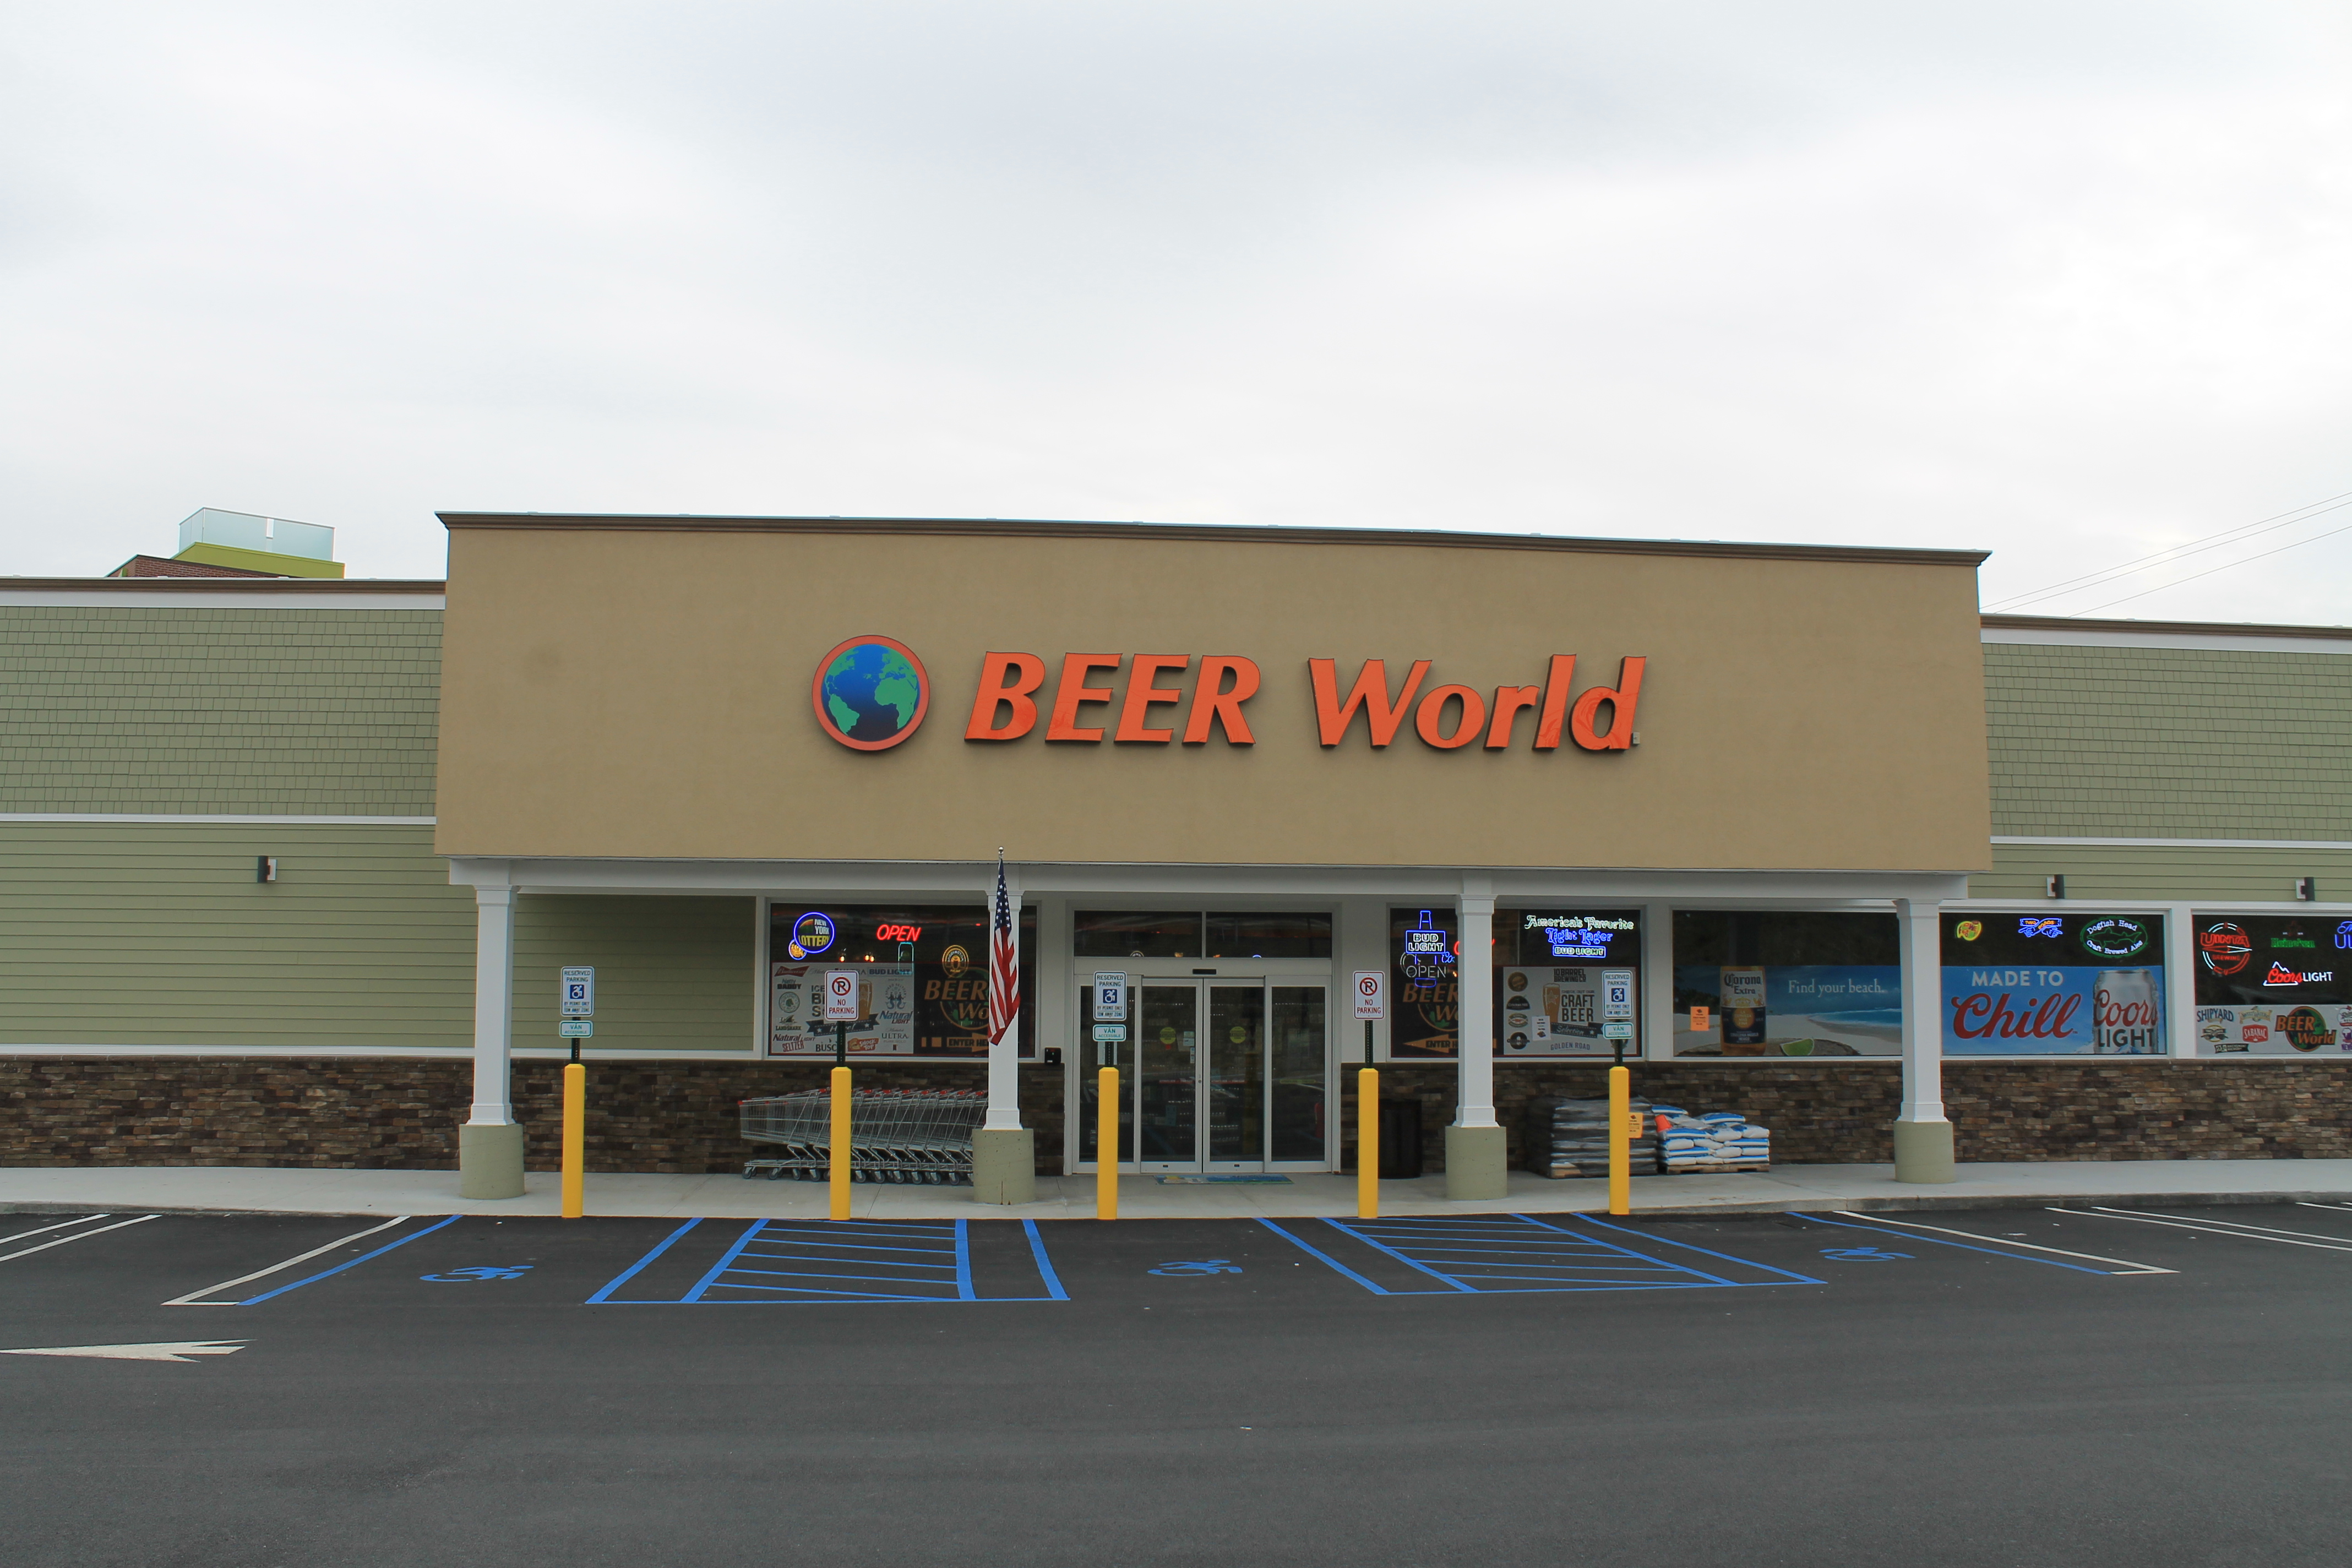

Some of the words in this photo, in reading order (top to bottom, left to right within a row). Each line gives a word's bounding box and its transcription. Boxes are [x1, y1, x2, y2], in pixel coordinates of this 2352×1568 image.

[964, 651, 1261, 745] BEER
[1308, 654, 1647, 751] World
[815, 925, 830, 935] YORK
[1584, 917, 1635, 931] Favorite
[2038, 920, 2056, 930] ROADS
[2087, 919, 2115, 934] Dogfish
[2118, 919, 2138, 932] Head
[876, 924, 922, 941] OPEN
[1413, 933, 1439, 942] BUD
[1545, 928, 1577, 945] Light
[1578, 929, 1613, 945] Lager
[798, 935, 830, 946] LOTTERY
[1408, 942, 1444, 952] LIGHT
[2087, 940, 2102, 952] Craft
[2131, 940, 2143, 951] Ales
[2200, 932, 2251, 948] UINTA
[2271, 938, 2316, 948] Heineken
[1554, 946, 1575, 955] BUD
[1575, 948, 1604, 956] LIGHT
[1406, 965, 1446, 978] OPEN
[1972, 971, 2032, 986] MADE
[2037, 971, 2065, 986] TO
[2267, 968, 2304, 983] Coors
[2302, 972, 2333, 982] LIGHT
[1724, 973, 1762, 988] Corona
[924, 980, 989, 1001] BEER
[1734, 986, 1756, 994] Extra
[1788, 978, 1816, 993] Find
[1817, 984, 1845, 998] your
[1561, 994, 1595, 1008] CRAFT
[2093, 989, 2158, 1027] Coors
[879, 1010, 914, 1019] Natural
[1562, 1008, 1594, 1022] BEER
[1951, 993, 2083, 1039] Chill
[2196, 1008, 2234, 1023] SHIPYARD
[1557, 1025, 1585, 1036] Selection
[2276, 1016, 2316, 1031] BEER
[859, 1039, 876, 1047] SHOCK
[2098, 1028, 2154, 1048] LIGHT
[2297, 1030, 2337, 1045] World
[782, 1040, 804, 1052] SELTZER
[815, 1043, 837, 1052] BUSC
[1550, 1042, 1573, 1050] GOLDEN
[1575, 1042, 1591, 1050] ROAD
